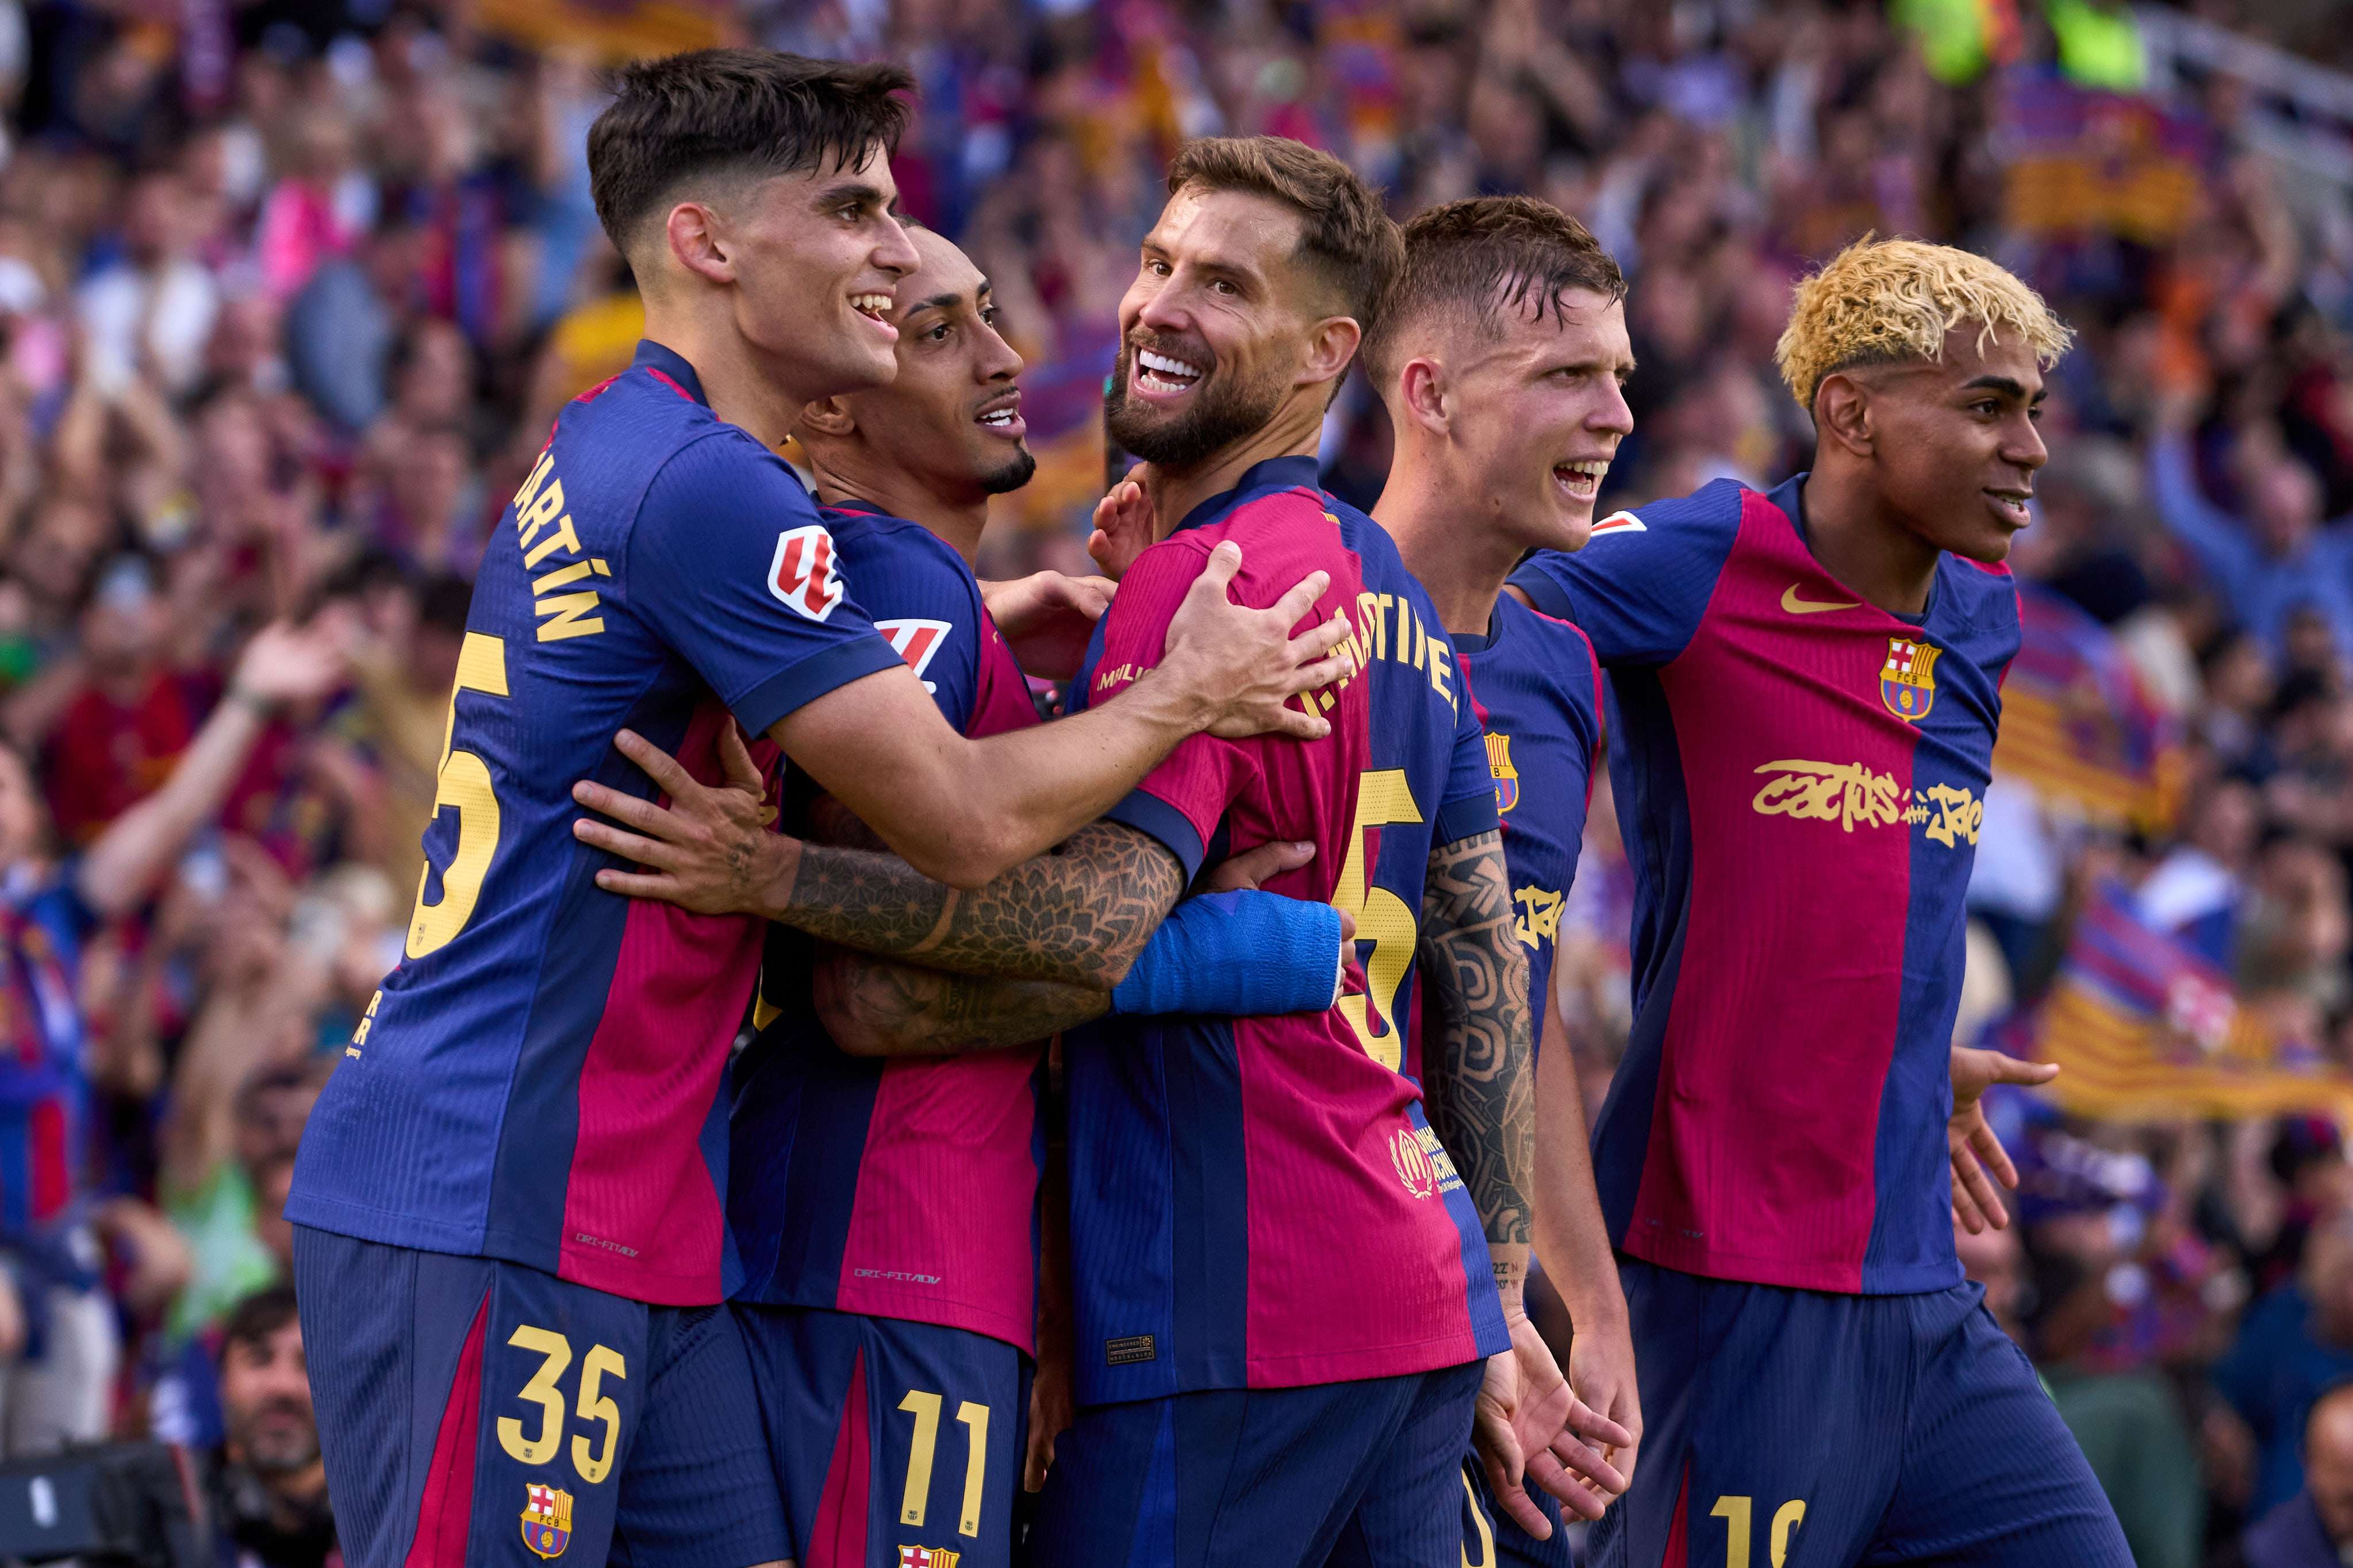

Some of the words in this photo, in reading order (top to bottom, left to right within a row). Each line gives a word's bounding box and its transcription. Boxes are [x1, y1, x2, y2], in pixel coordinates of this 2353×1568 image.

[513, 444, 612, 642] ARTÍN
[1925, 782, 1982, 848] Jac
[1413, 1125, 1444, 1154] UNHC
[1429, 1150, 1458, 1181] ACNU
[497, 1324, 626, 1484] 35
[897, 1389, 989, 1538] 11
[539, 1515, 560, 1527] FCB
